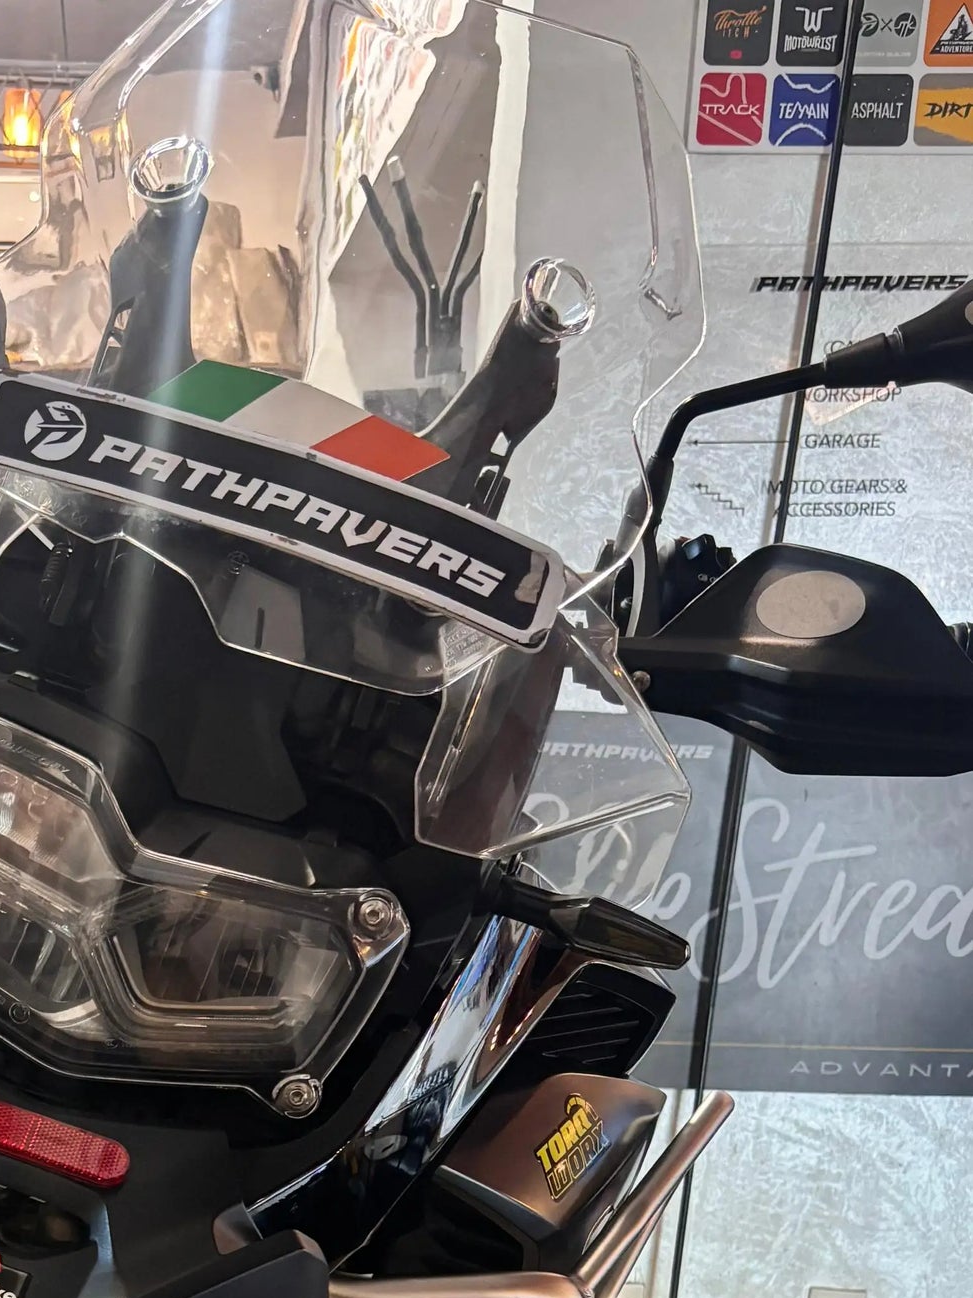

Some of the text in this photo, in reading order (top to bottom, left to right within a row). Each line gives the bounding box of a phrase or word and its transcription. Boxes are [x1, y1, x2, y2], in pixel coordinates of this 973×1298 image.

[784, 35, 837, 52] MOTOWRIST
[703, 104, 760, 115] TRACK
[851, 102, 903, 119] ASPHALT
[924, 101, 973, 119] DIRT
[755, 275, 968, 292] PATHPAVERS
[804, 434, 881, 449] GARAGE
[829, 479, 889, 494] GEARS
[895, 480, 908, 493] &
[89, 434, 506, 598] PATHPAVERS
